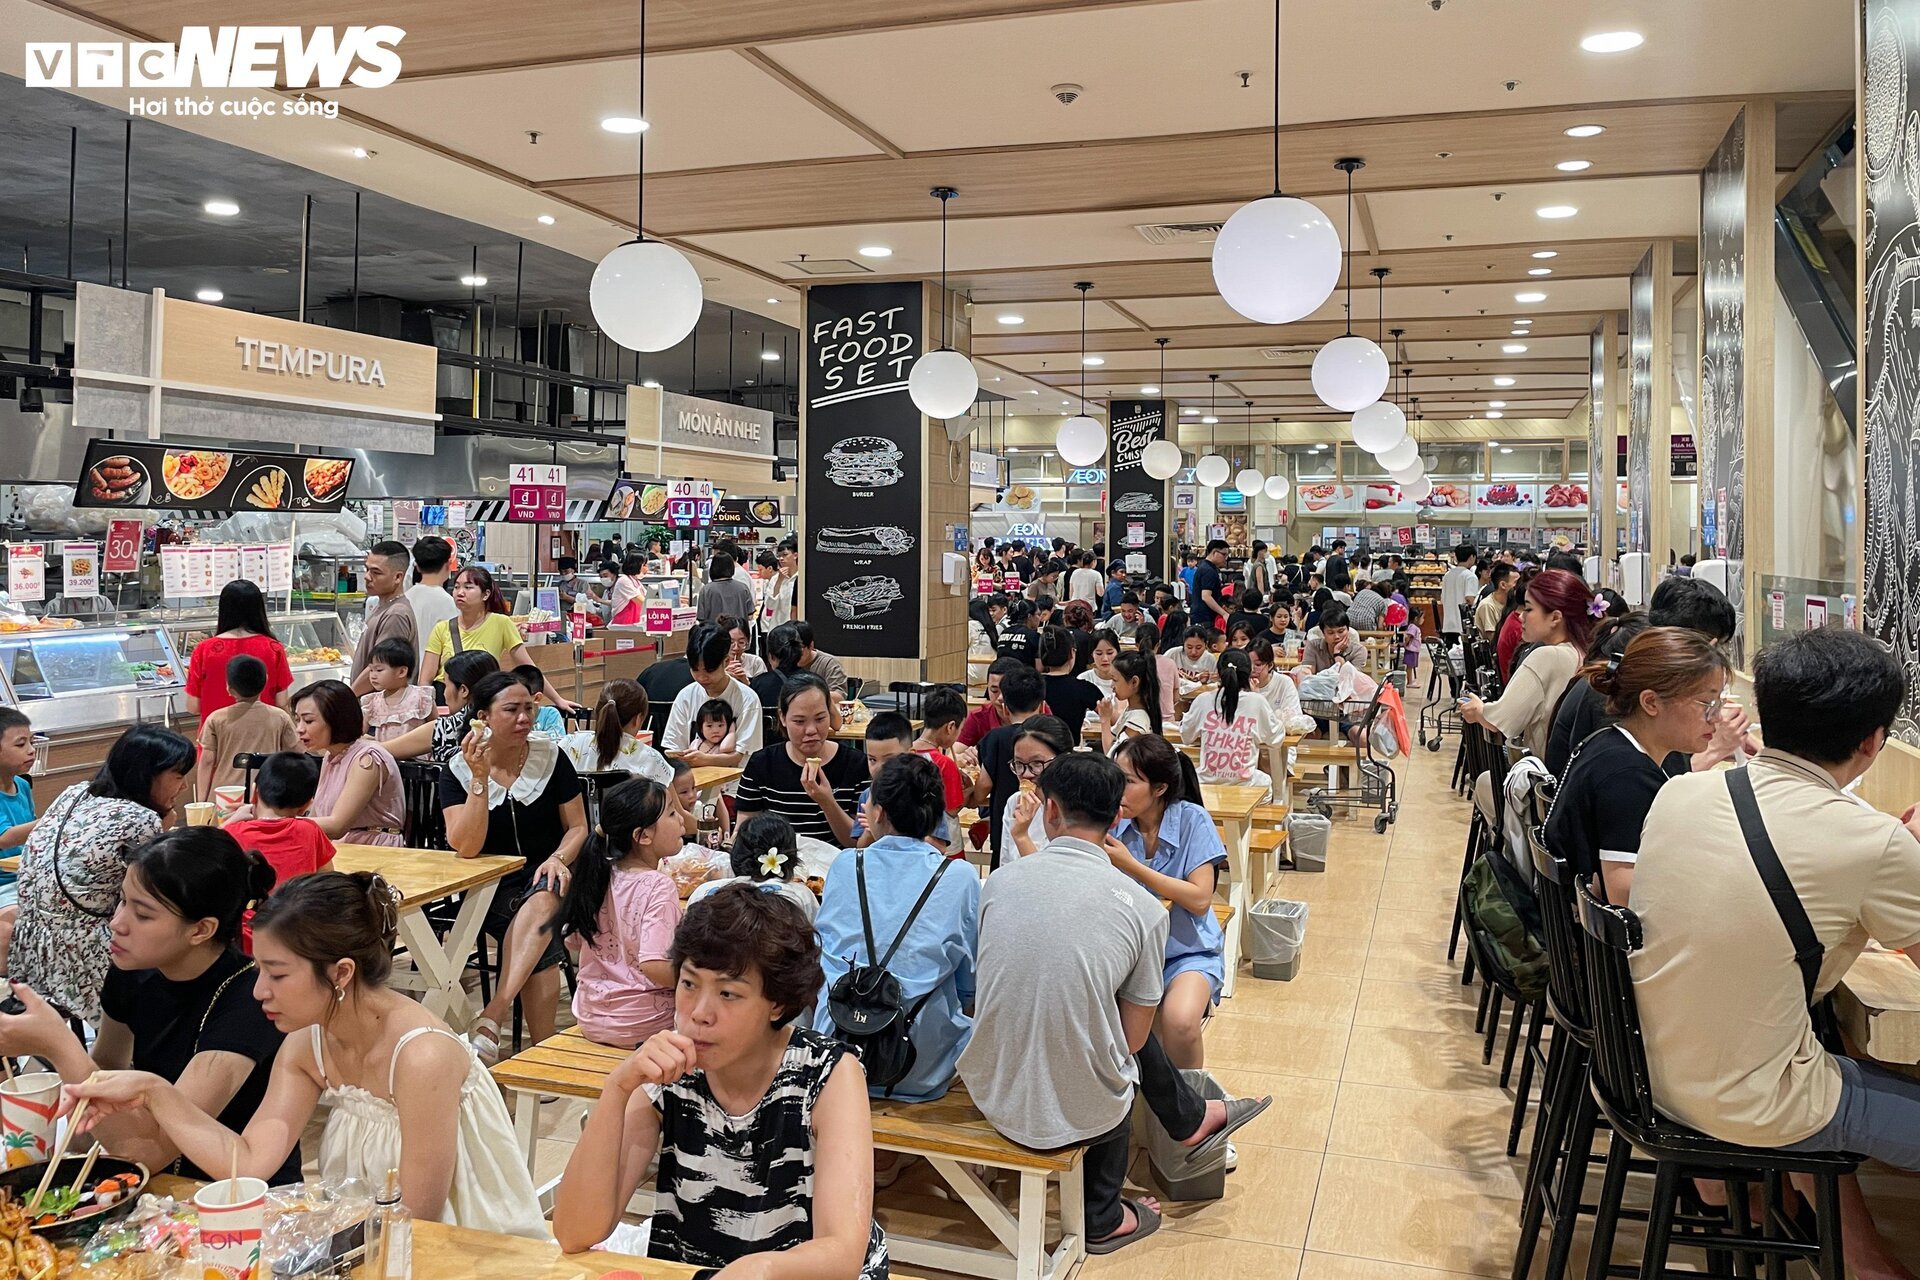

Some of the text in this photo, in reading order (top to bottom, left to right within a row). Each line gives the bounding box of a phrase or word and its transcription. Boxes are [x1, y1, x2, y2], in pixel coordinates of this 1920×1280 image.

[813, 306, 904, 344] FAST
[819, 333, 913, 367] FOOD
[235, 336, 386, 388] TEMPURA
[824, 355, 914, 390] SET
[679, 407, 761, 444] MÓN ĂN NHẸ
[1112, 427, 1158, 453] Best
[517, 466, 534, 482] 41
[547, 467, 560, 483] 41
[674, 482, 691, 495] 40
[700, 483, 710, 496] 40
[517, 510, 535, 518] VND
[548, 511, 560, 519] VND
[1400, 533, 1410, 541] 30
[109, 539, 133, 559] 30
